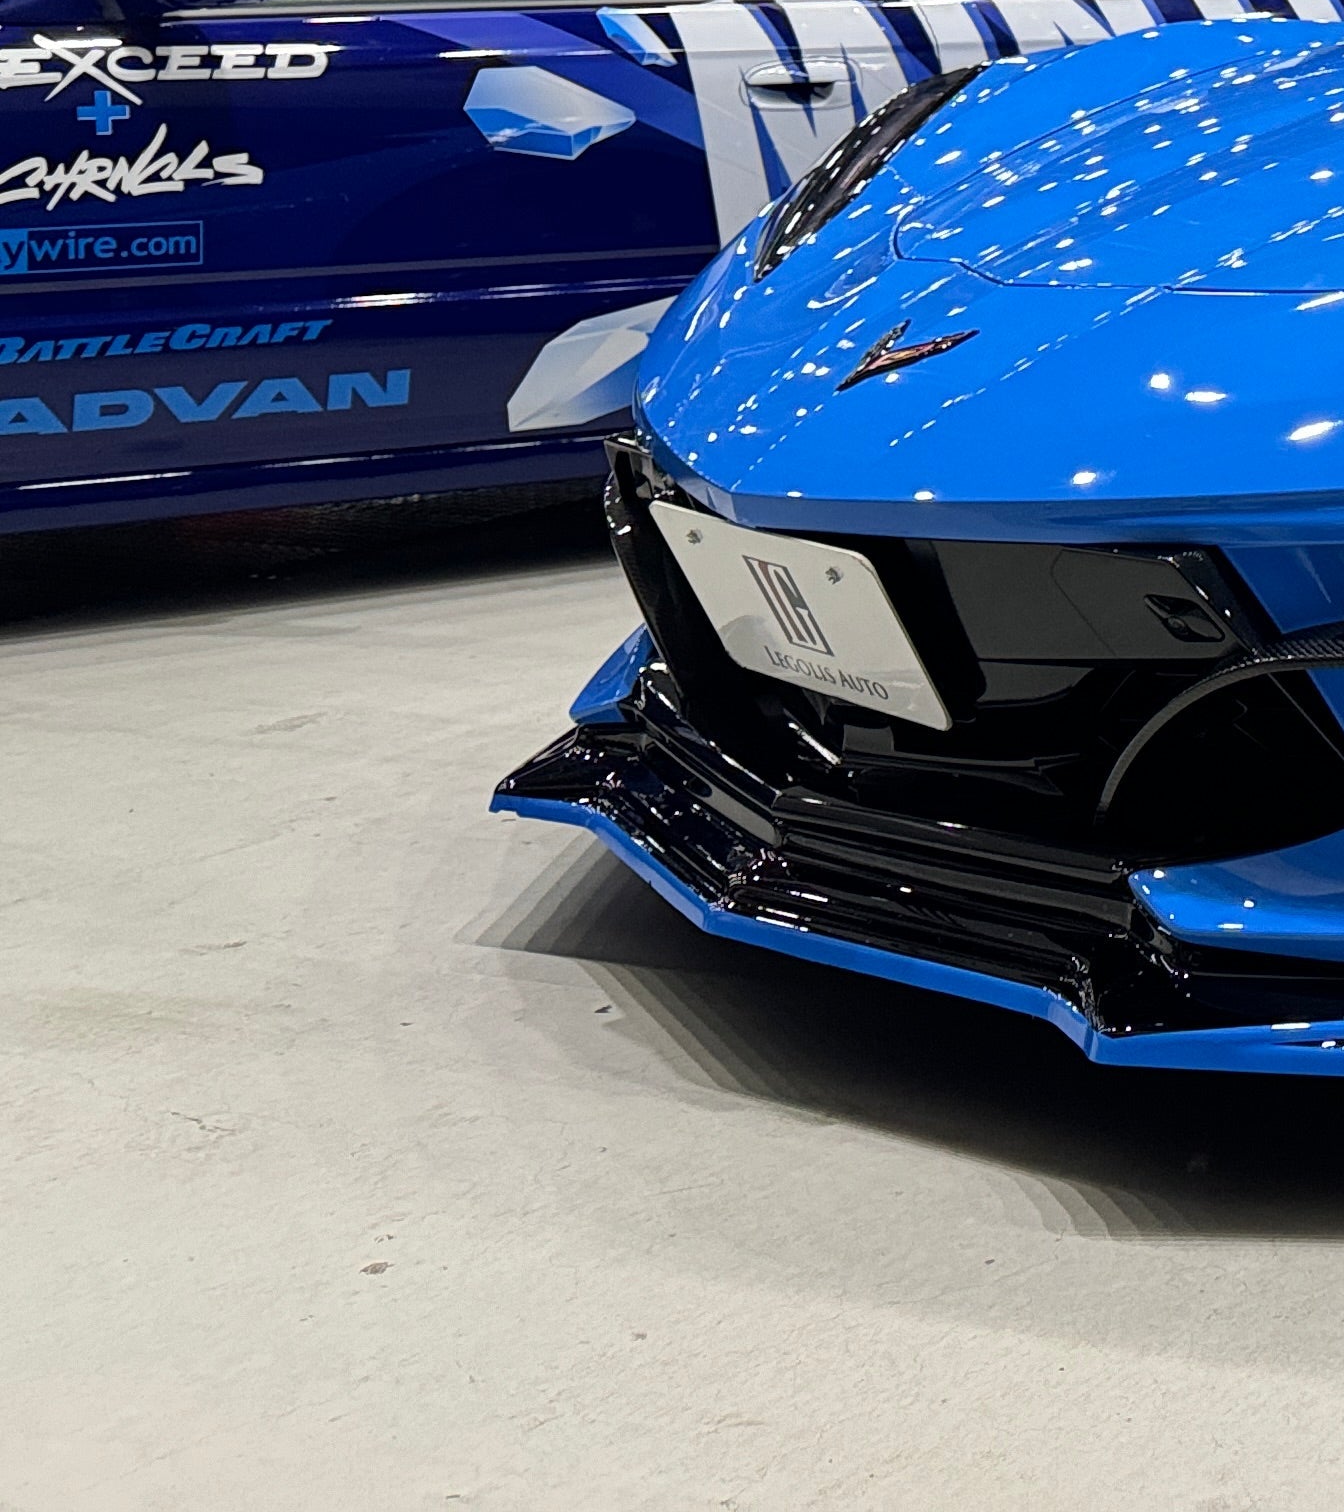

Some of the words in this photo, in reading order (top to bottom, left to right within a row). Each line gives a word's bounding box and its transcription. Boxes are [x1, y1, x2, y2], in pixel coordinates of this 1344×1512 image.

[0, 231, 197, 270] ywire.com
[0, 369, 411, 435] ADVAN
[764, 645, 836, 684] LEGOLIS
[839, 669, 889, 700] AUTO
